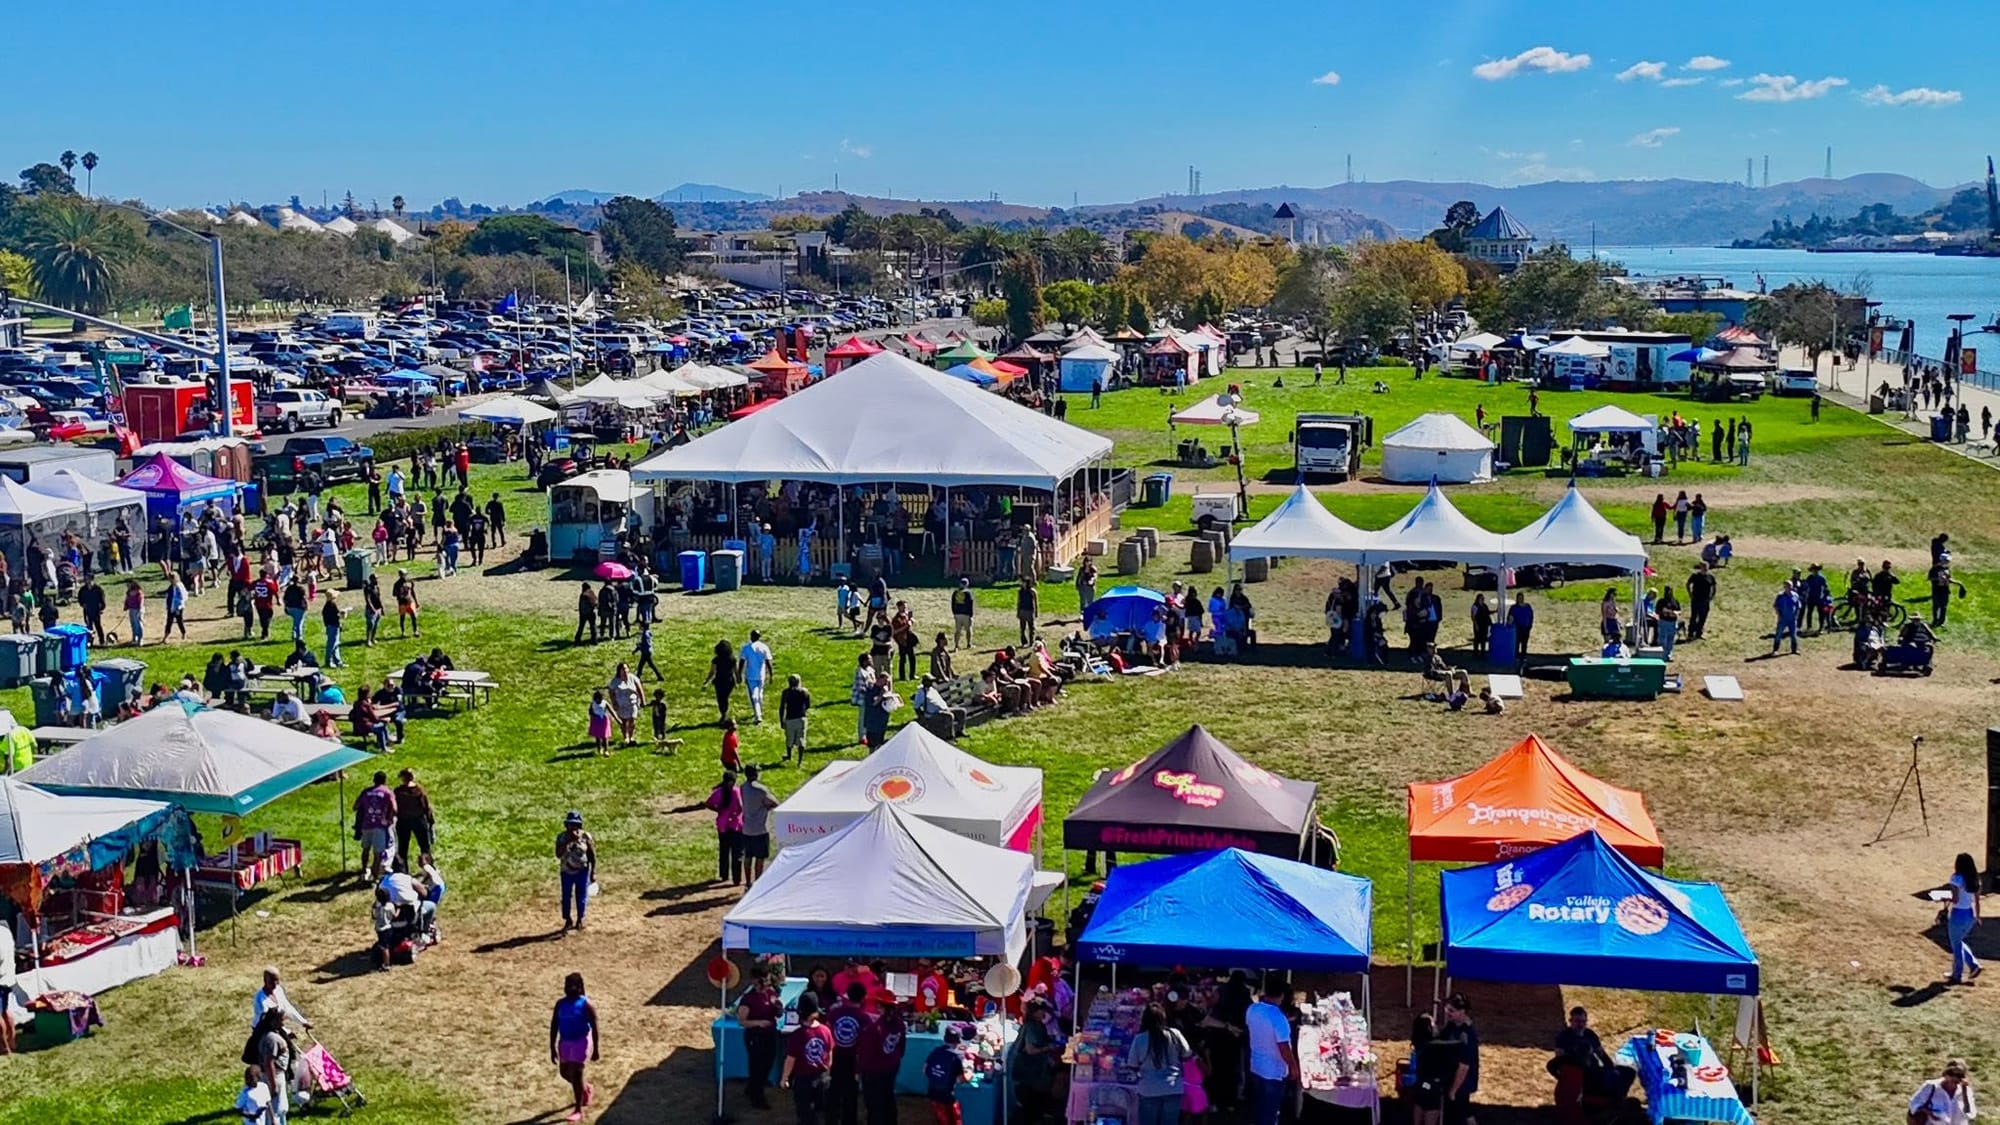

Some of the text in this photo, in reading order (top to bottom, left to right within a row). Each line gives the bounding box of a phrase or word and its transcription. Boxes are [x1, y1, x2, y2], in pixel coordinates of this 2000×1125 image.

[1468, 802, 1598, 828] Orangetheory
[787, 823, 815, 834] Boys
[1566, 895, 1611, 907] Vallejo
[1528, 903, 1611, 924] Rotary
